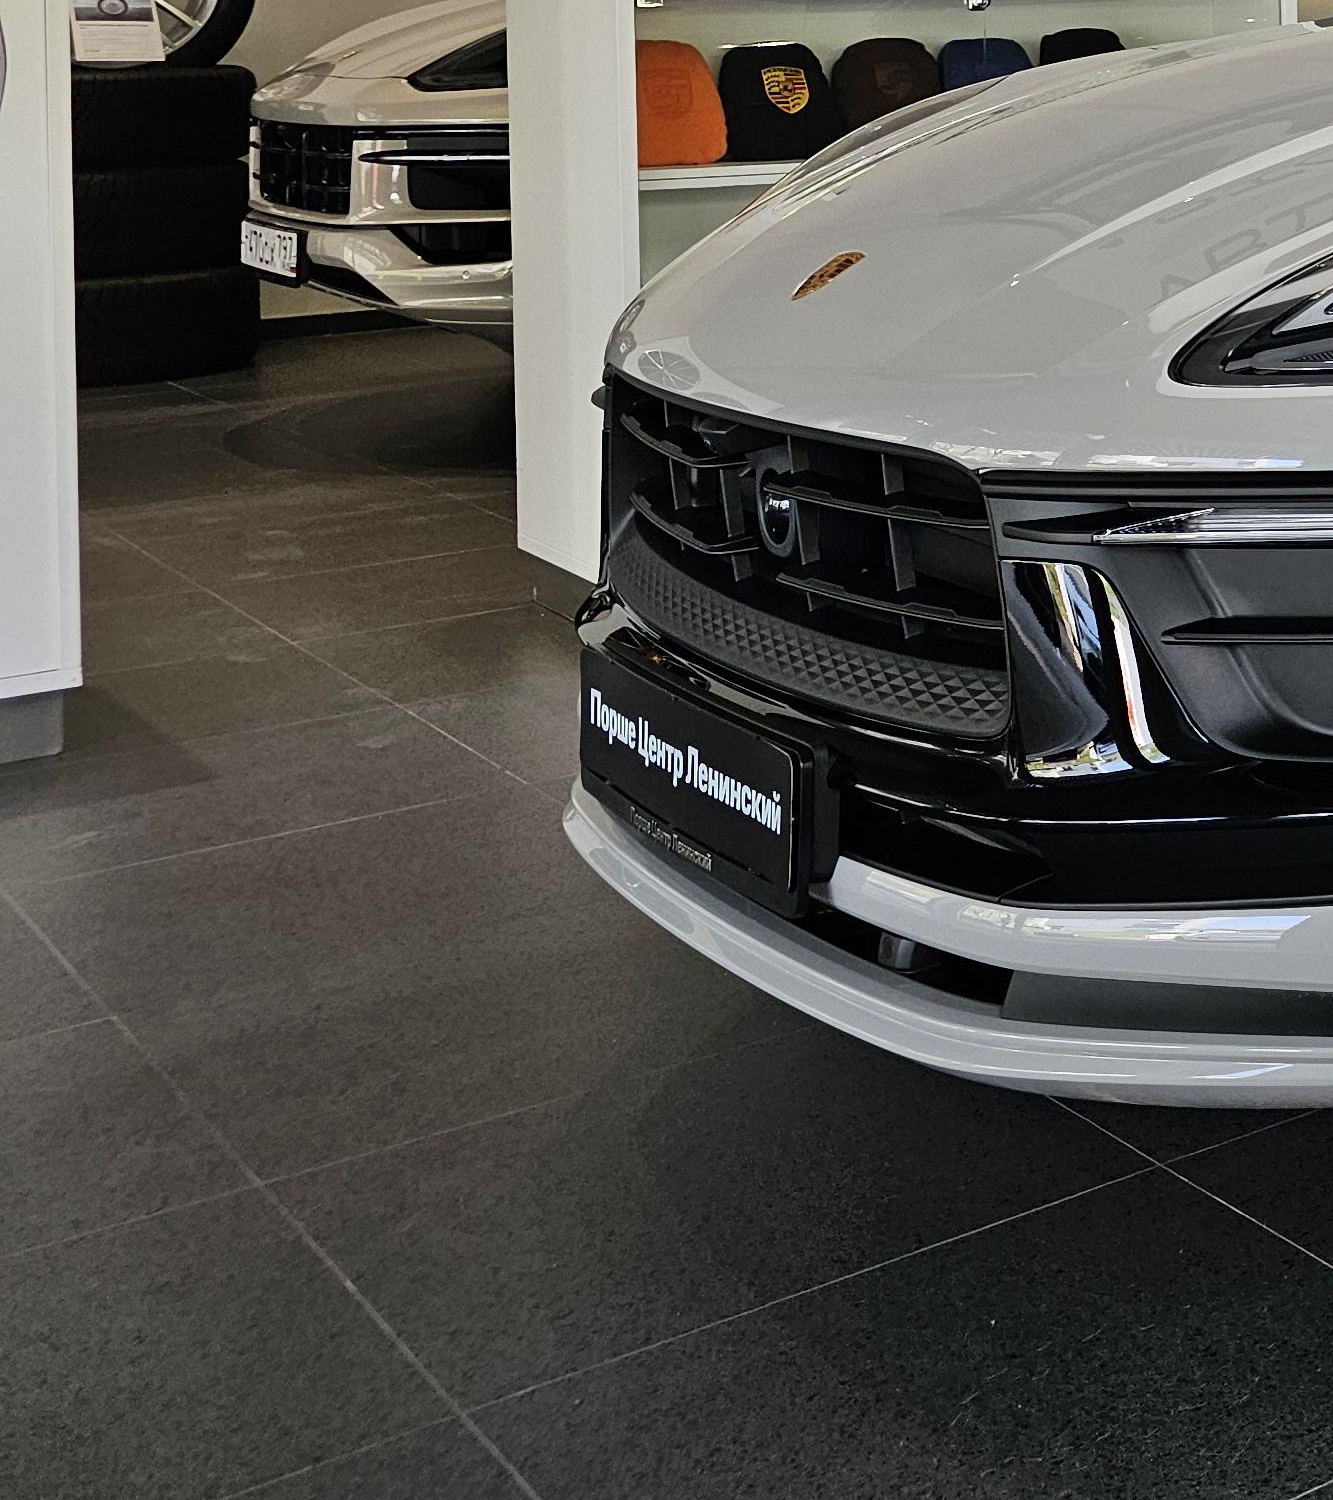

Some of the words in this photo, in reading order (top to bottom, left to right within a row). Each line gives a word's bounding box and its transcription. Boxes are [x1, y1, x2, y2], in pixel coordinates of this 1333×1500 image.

[590, 687, 637, 749] Порше
[637, 716, 684, 788] Центр
[685, 745, 782, 836] Ленинский
